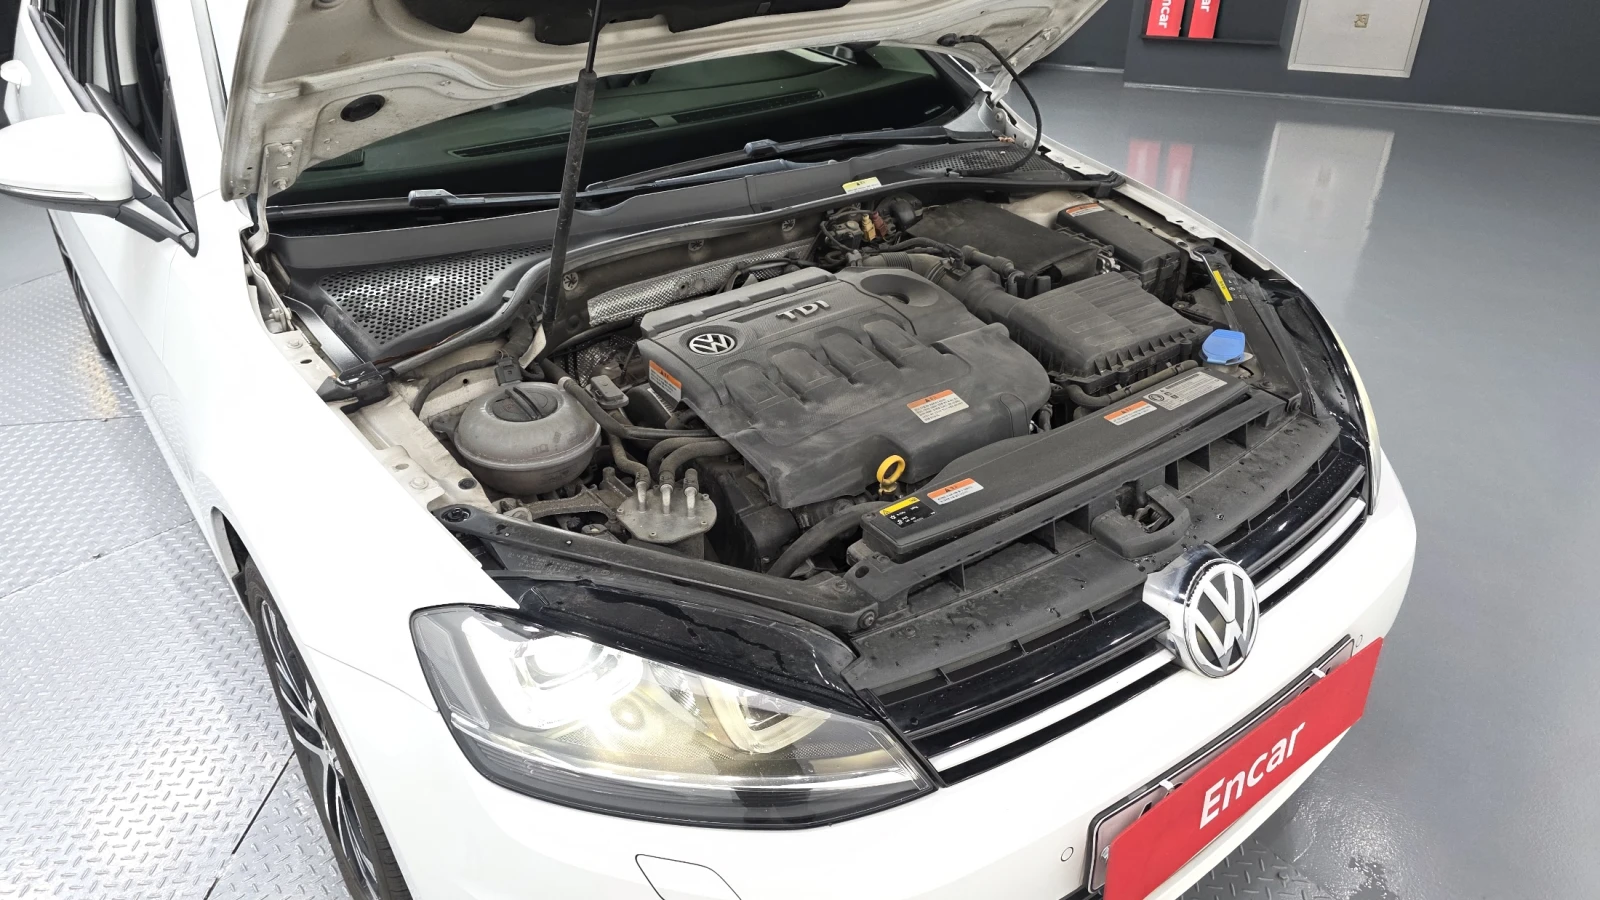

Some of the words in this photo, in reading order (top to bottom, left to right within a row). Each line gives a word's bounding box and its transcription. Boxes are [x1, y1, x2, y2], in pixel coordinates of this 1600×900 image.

[777, 300, 830, 320] TDI
[689, 333, 736, 356] VW
[1185, 559, 1258, 678] VW
[1199, 721, 1305, 830] Encar
